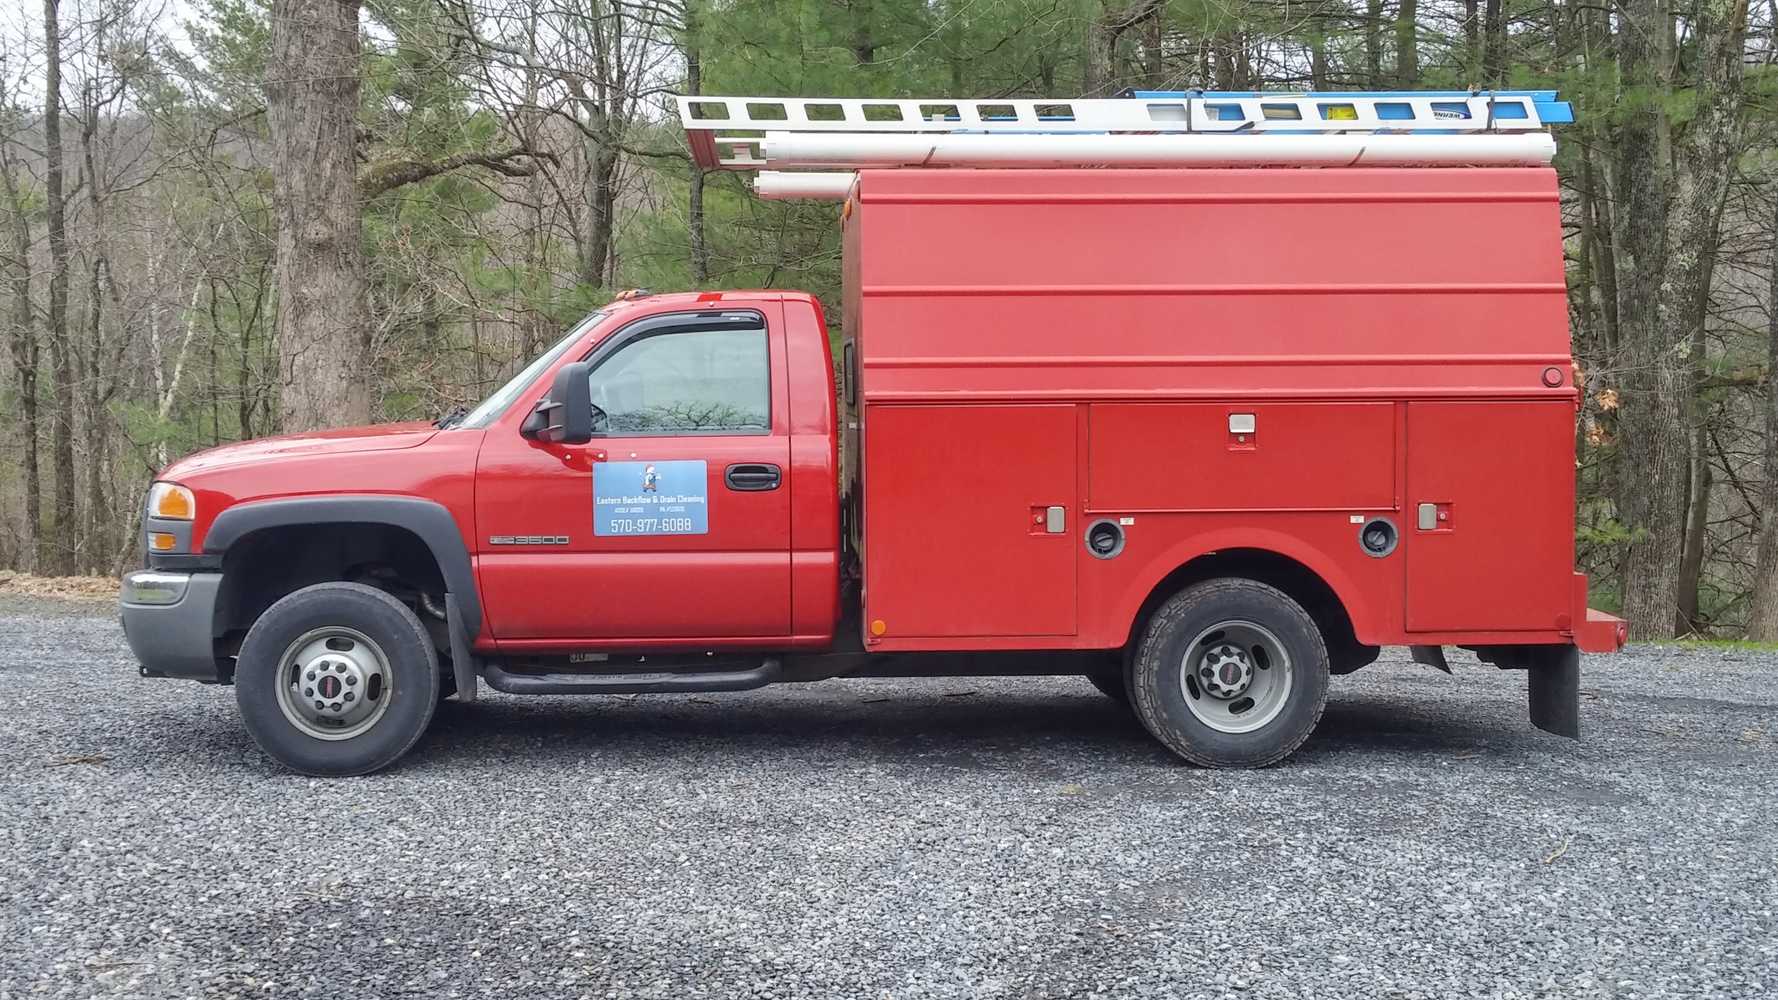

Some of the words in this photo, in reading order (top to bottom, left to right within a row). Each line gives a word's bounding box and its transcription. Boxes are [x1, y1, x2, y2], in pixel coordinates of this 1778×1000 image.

[596, 496, 621, 505] Eastern
[622, 495, 651, 505] Backflow
[660, 495, 676, 504] Drain
[677, 494, 705, 504] Cleaning
[610, 518, 692, 533] 570-977-6088
